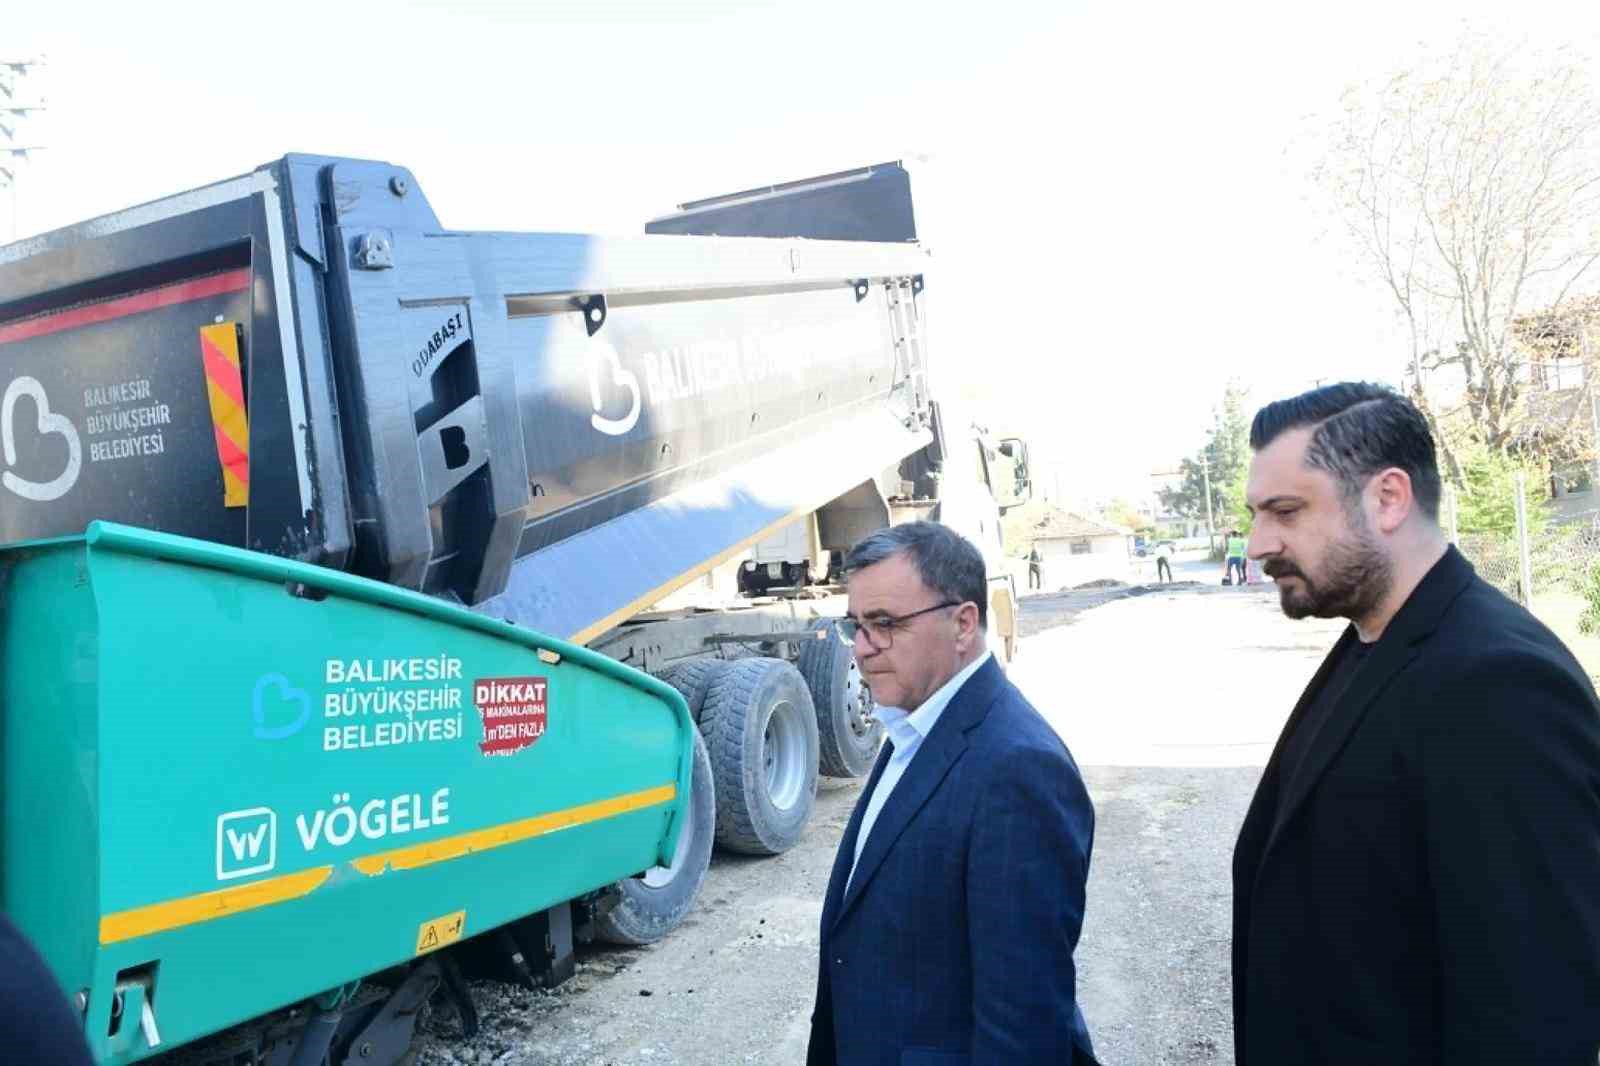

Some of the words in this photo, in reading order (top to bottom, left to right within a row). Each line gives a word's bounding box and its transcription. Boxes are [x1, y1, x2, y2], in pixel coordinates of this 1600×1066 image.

[412, 311, 463, 378] ODABAŞI
[83, 376, 151, 408] BALIKESİR
[86, 399, 171, 435] BÜYÜKŞEHİR
[90, 428, 164, 462] BELEDİYESİ
[325, 653, 463, 684] BALIKESİR
[324, 683, 462, 719] BÜYÜKŞEHİR
[476, 681, 546, 704] DİKKAT
[323, 712, 463, 751] BELEDİYESİ
[296, 787, 450, 852] VÖGELE
